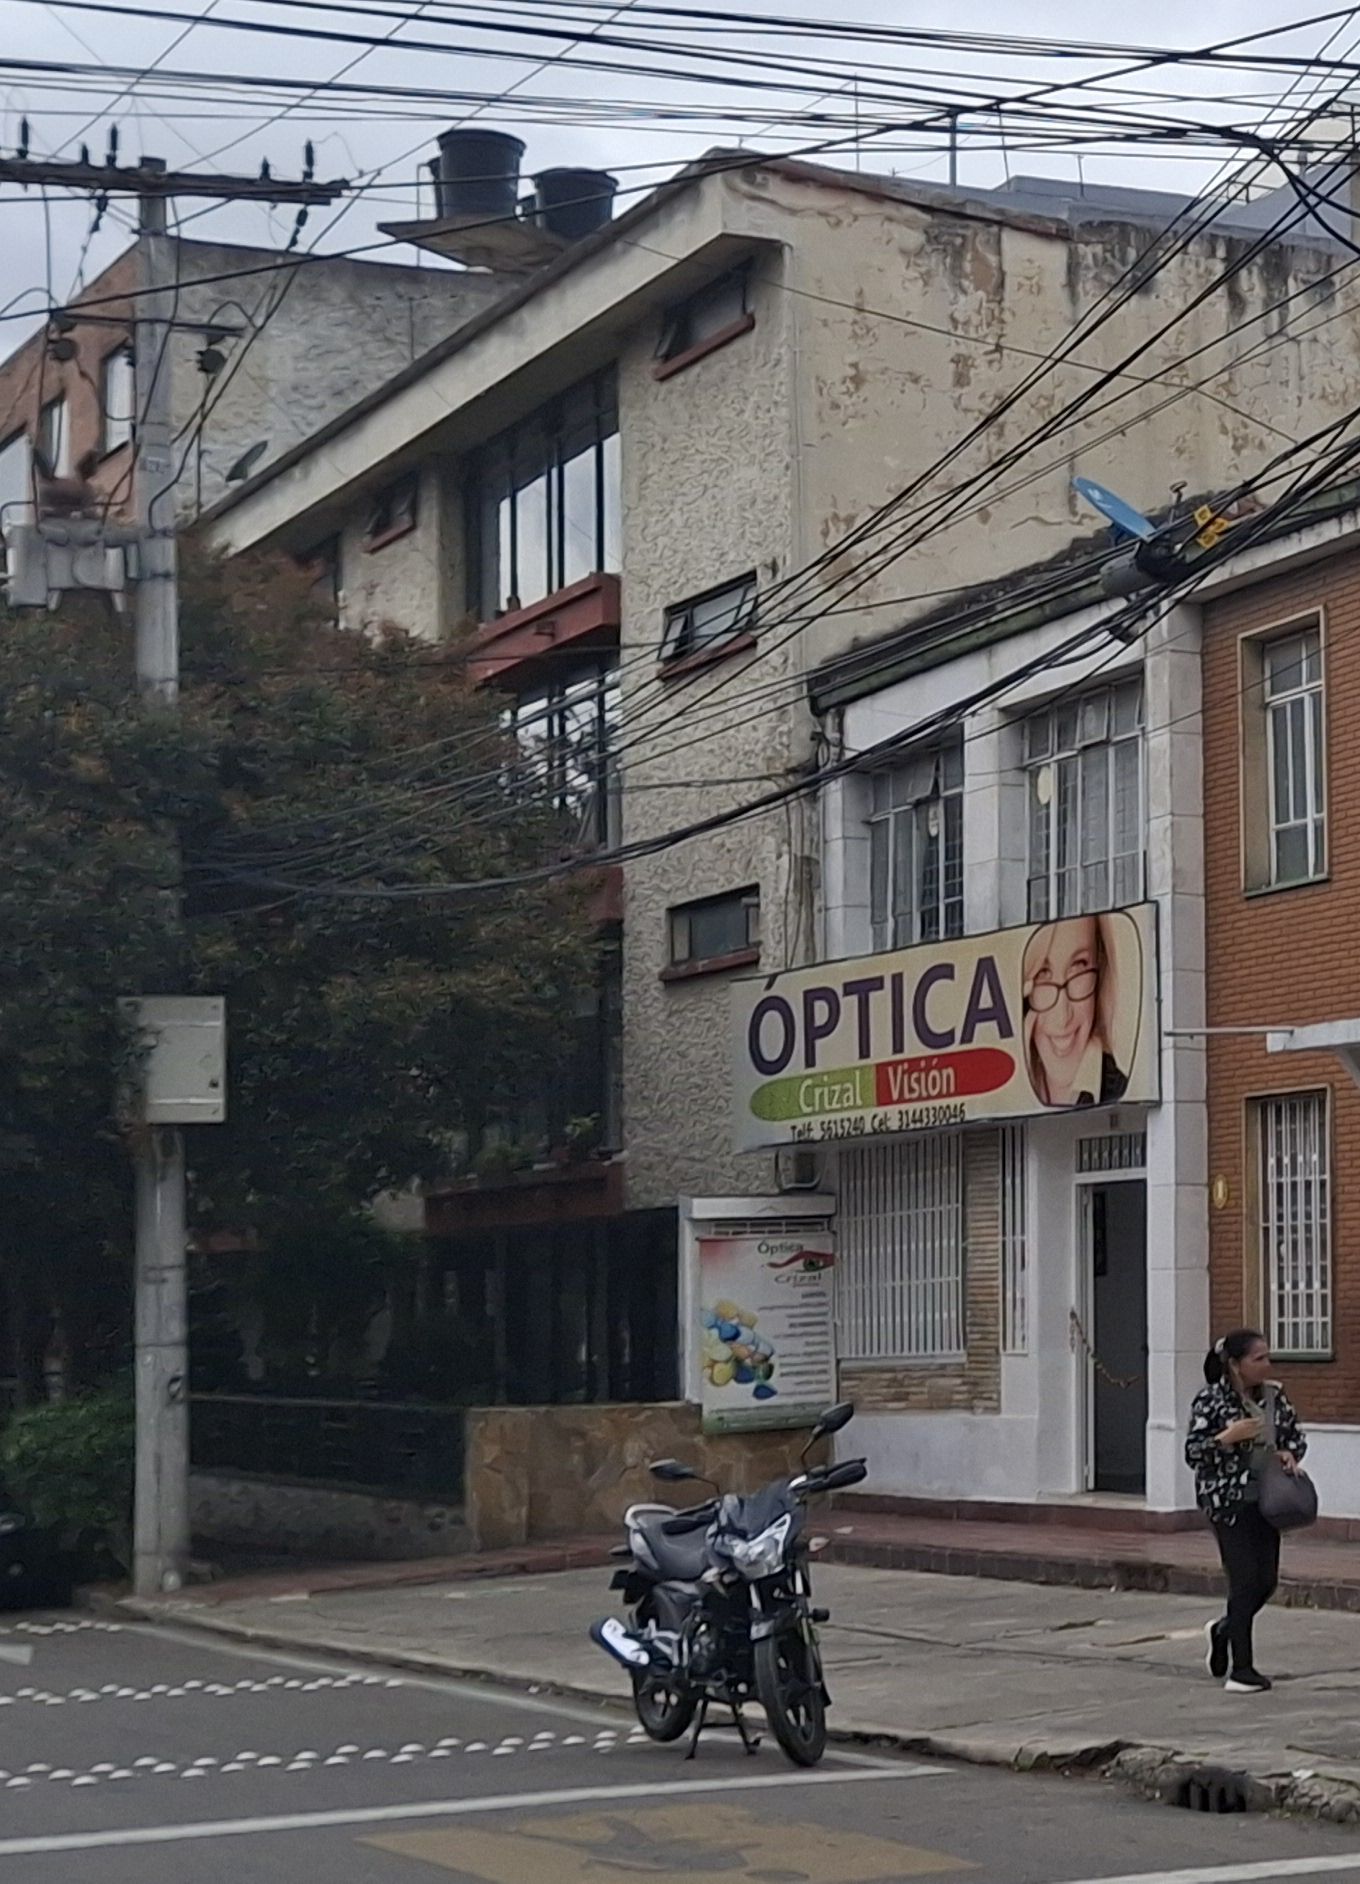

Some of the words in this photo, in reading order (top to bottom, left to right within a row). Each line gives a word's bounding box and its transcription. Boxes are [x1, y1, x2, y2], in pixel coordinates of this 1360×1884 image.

[748, 955, 1014, 1076] ÓPTICA
[798, 1071, 863, 1114] Crizal
[887, 1057, 957, 1101] Visión
